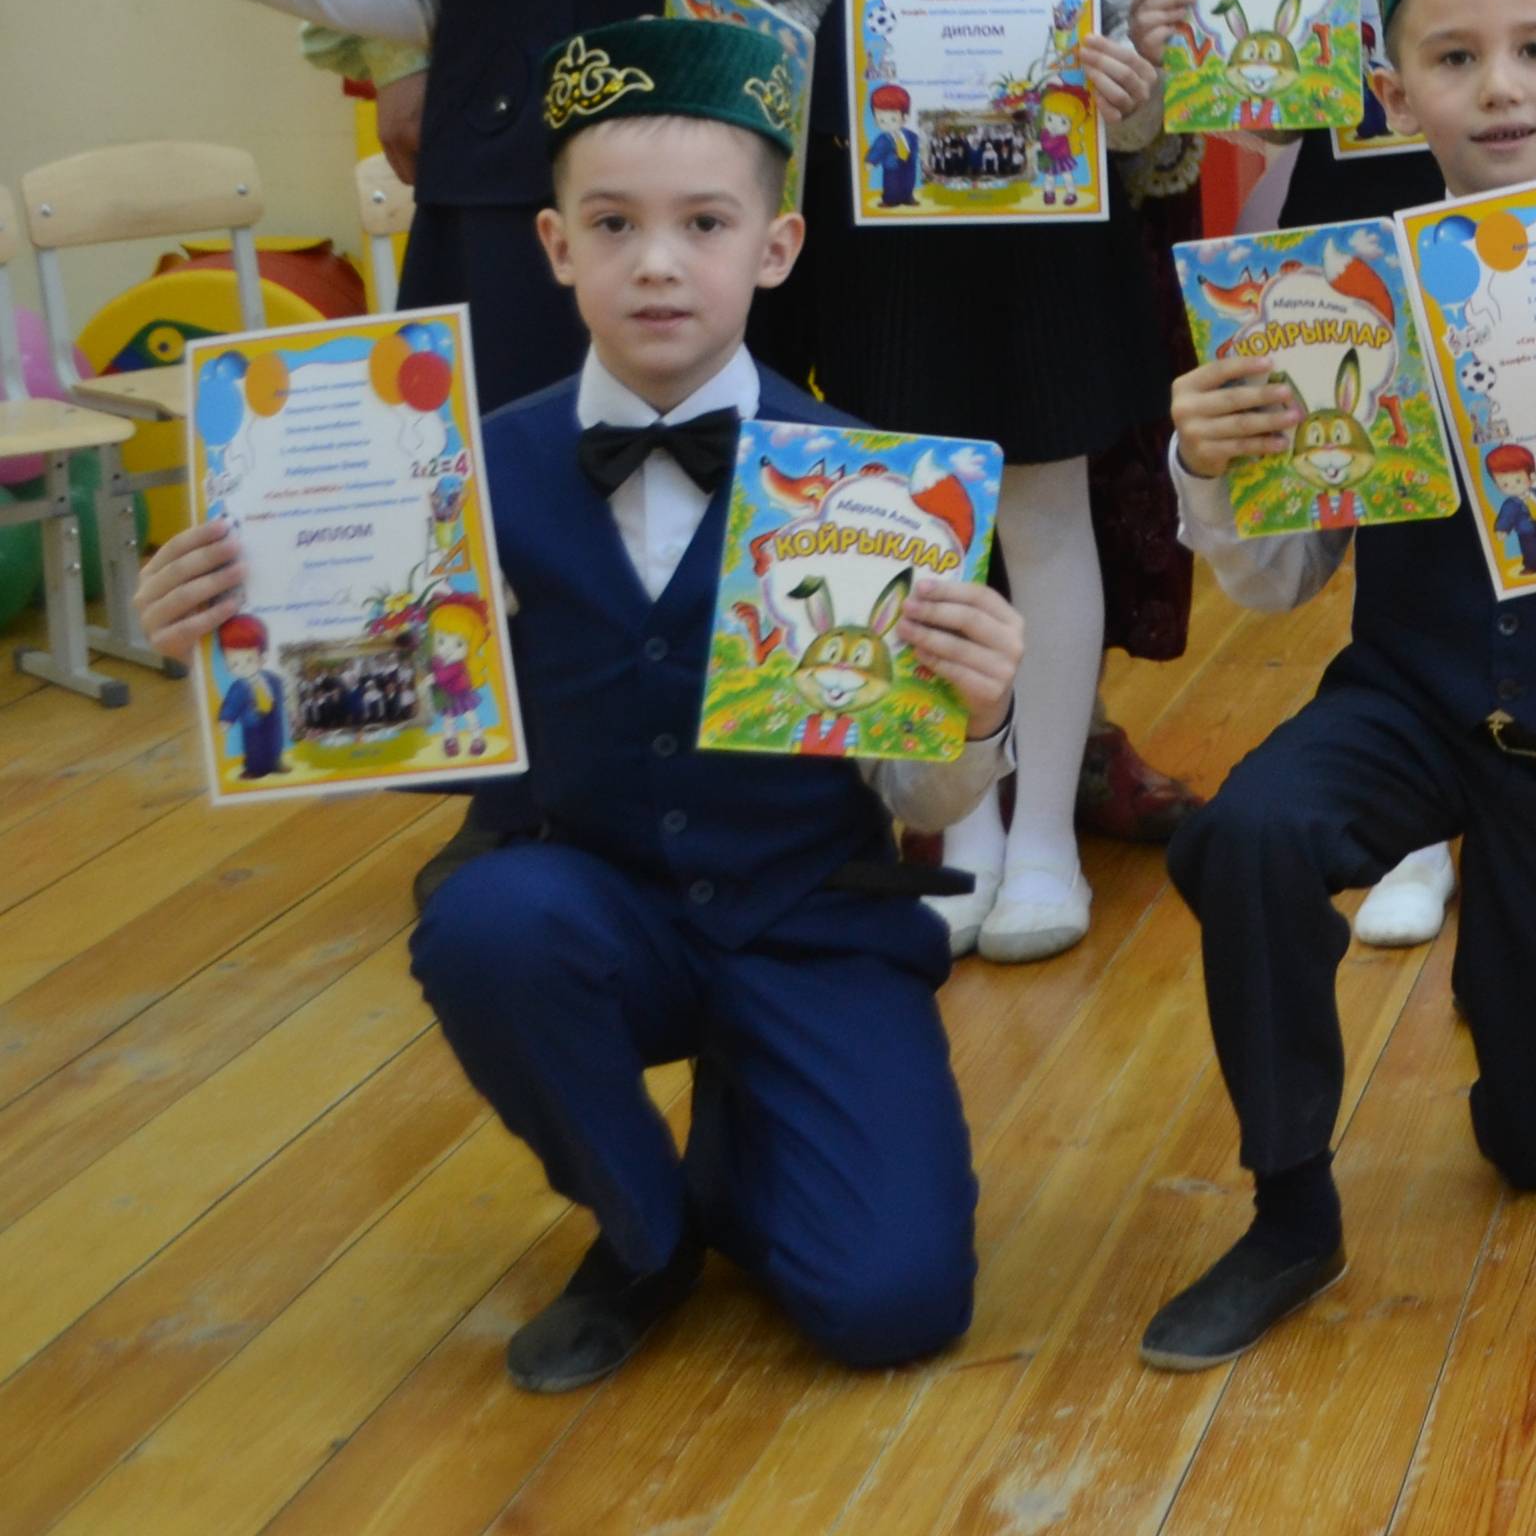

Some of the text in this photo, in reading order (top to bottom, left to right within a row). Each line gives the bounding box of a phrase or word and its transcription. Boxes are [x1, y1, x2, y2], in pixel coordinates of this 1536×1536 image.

[942, 24, 1006, 40] ДИПЛОМ
[296, 522, 374, 549] ДИПЛОМ
[774, 521, 962, 575] КОЙРЫКЛАР
